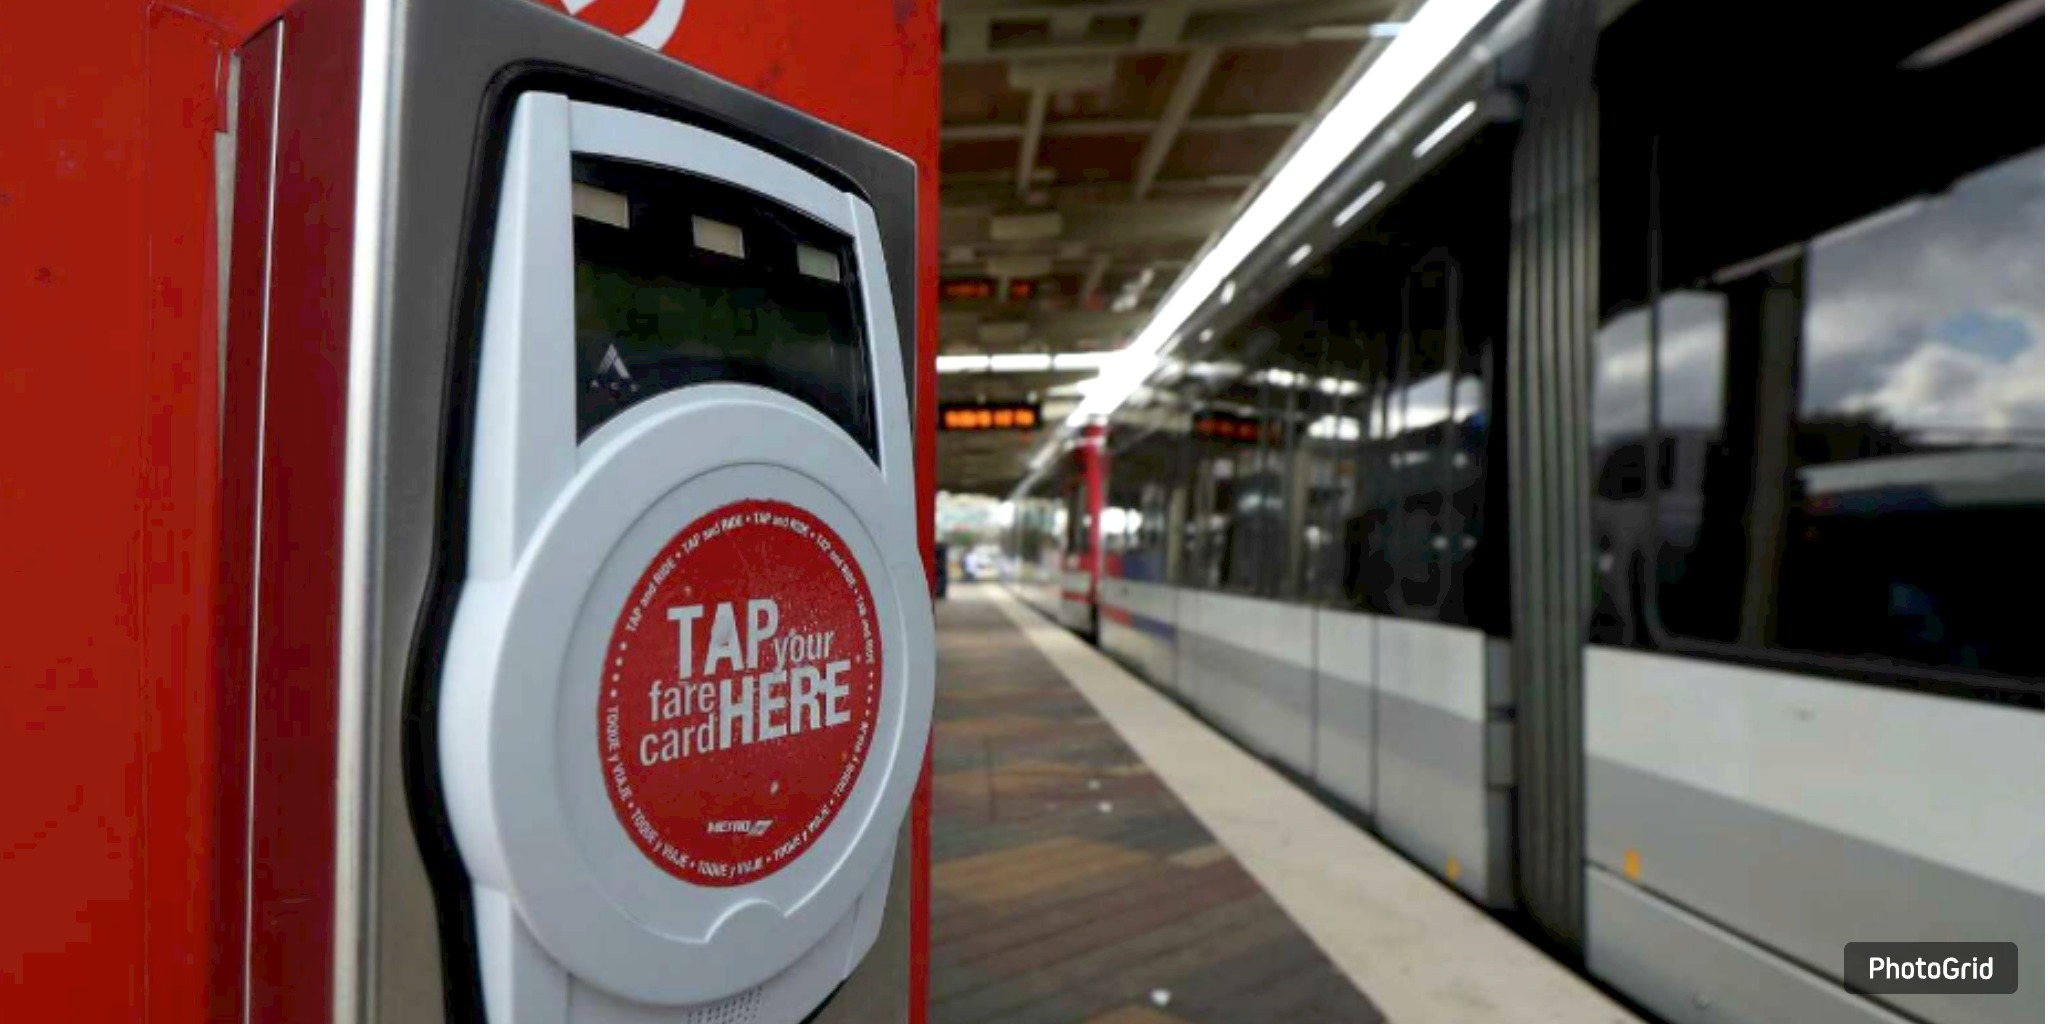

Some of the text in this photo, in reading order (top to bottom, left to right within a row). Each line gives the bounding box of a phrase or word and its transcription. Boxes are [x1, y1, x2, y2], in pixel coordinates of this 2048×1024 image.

[625, 607, 642, 632] TAP
[653, 557, 676, 585] RIDE
[681, 533, 700, 553] TAP
[702, 520, 720, 541] and
[721, 514, 742, 531] RIDE
[666, 598, 835, 679] TAP your
[639, 660, 850, 767] card HERE
[650, 679, 716, 722] fare
[607, 705, 620, 752] TOQUE
[613, 762, 632, 801] VIAJE
[632, 807, 659, 844] TOQUE
[707, 820, 751, 832] METRO
[661, 842, 689, 868] VIAJE
[697, 860, 727, 876] TOQUE
